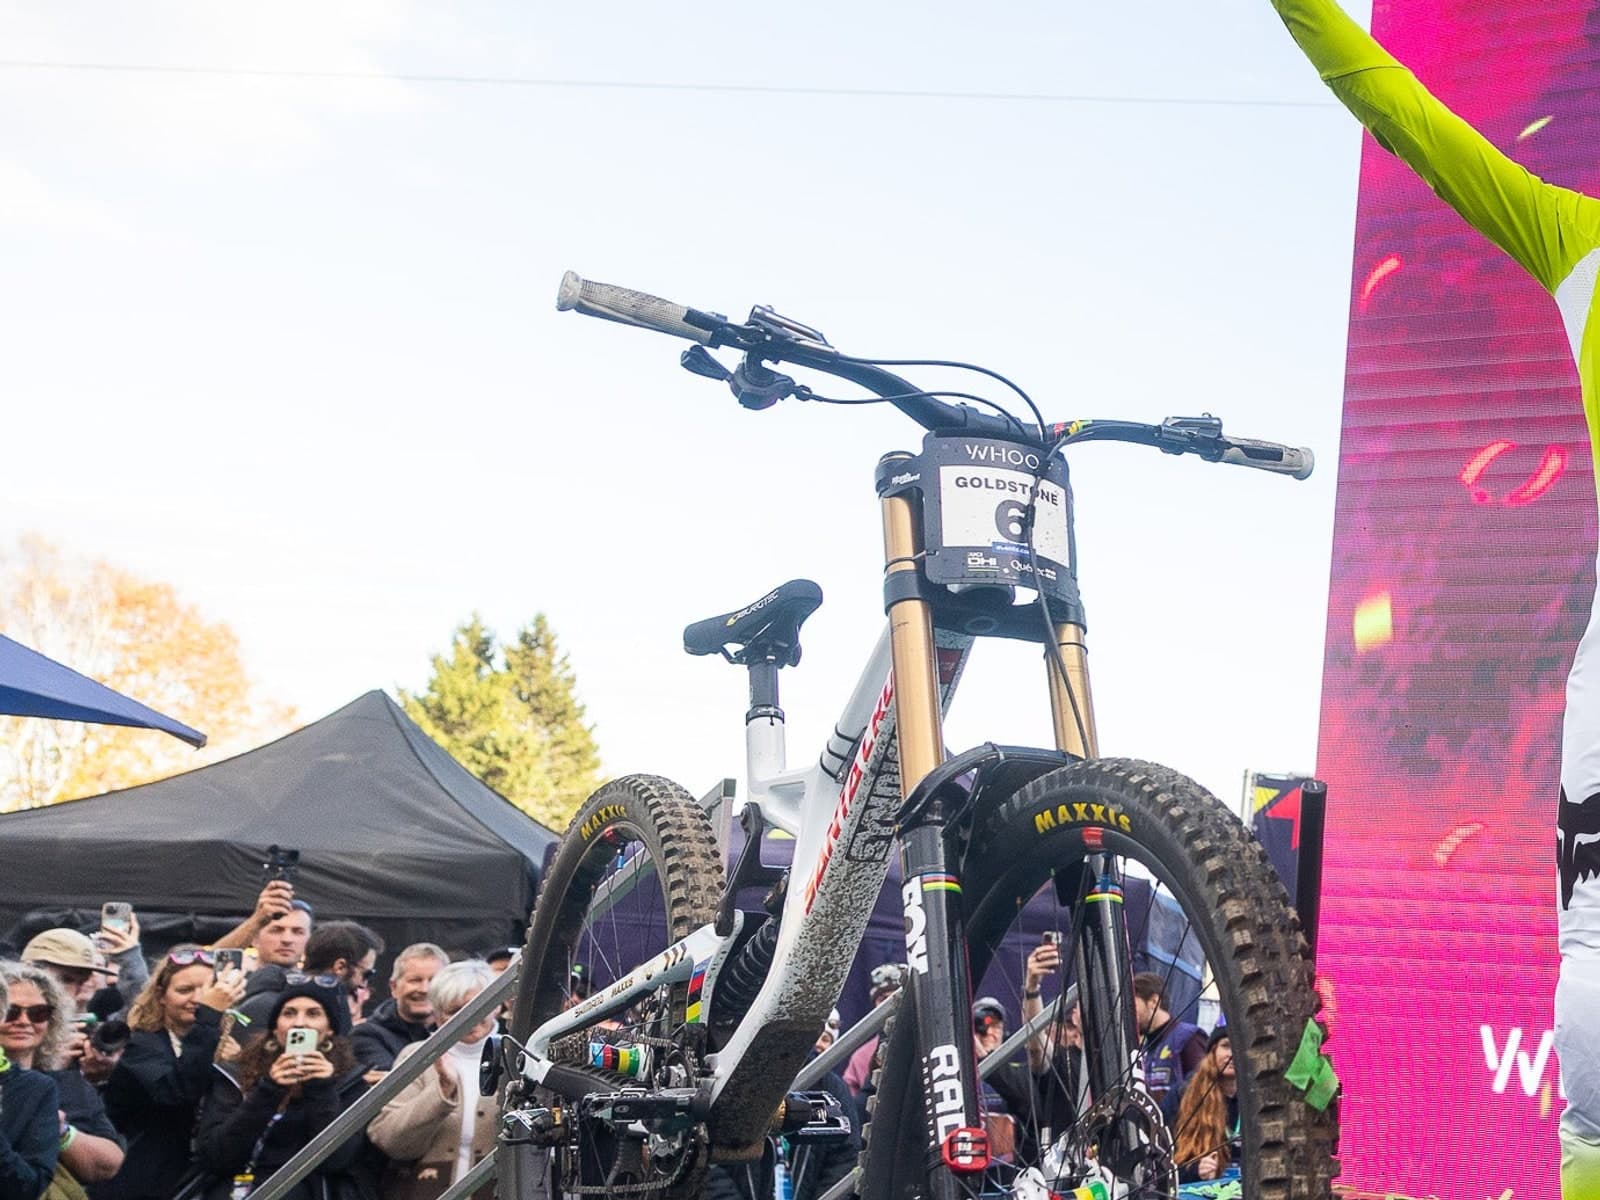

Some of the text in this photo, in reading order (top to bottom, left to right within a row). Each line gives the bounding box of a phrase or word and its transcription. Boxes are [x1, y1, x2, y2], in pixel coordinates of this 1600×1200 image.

[965, 444, 1040, 470] WHOO
[955, 476, 1059, 507] GOLDSTONE
[995, 499, 1033, 544] 6
[861, 669, 895, 763] CRU
[580, 804, 628, 841] MAXXIS
[1033, 802, 1132, 834] MAXXIS
